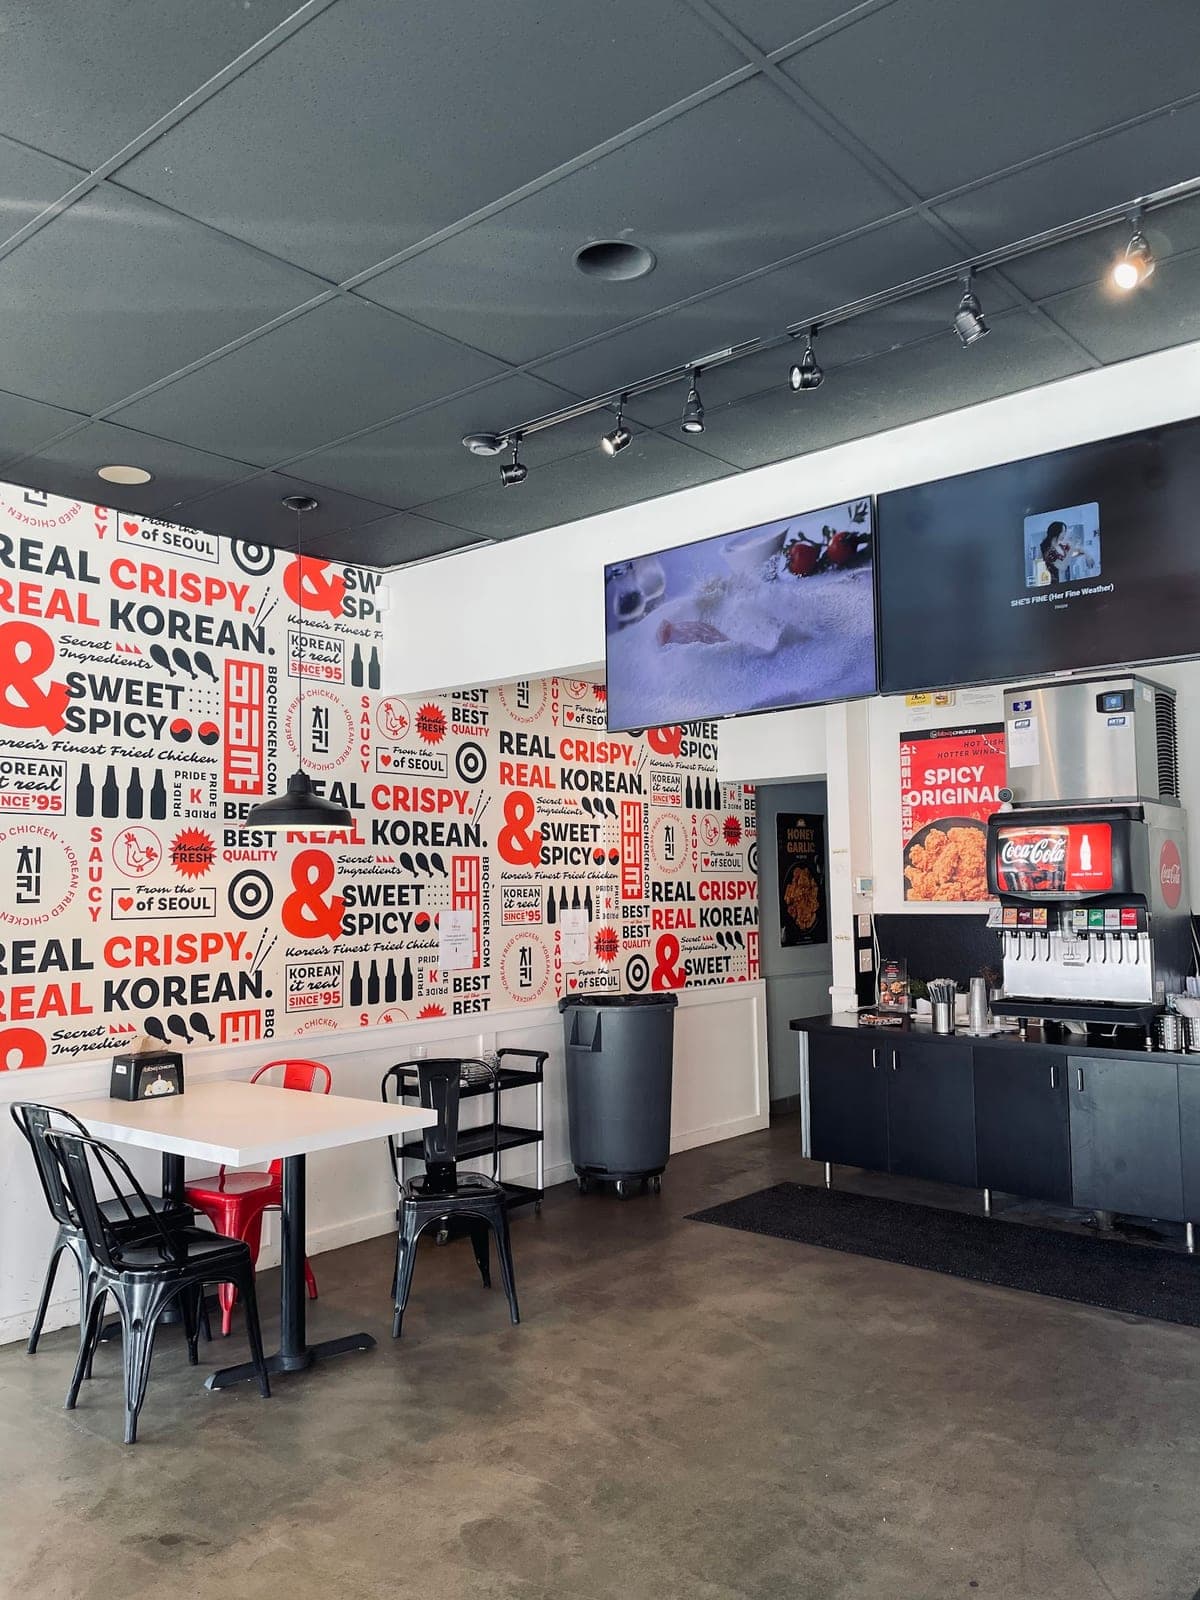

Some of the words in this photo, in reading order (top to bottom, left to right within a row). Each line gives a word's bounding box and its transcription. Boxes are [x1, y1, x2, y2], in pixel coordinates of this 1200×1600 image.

[162, 532, 215, 556] SEOUL
[109, 558, 256, 615] CRISPY.
[1065, 589, 1081, 600] Fine
[1081, 583, 1114, 595] Weather)
[110, 598, 276, 656] KOREAN.
[58, 634, 113, 651] Secret
[290, 634, 342, 654] KOREAN
[59, 647, 154, 670] Ingredients
[309, 650, 341, 664] real
[65, 671, 185, 710] SWEET
[64, 705, 169, 741] SPICY
[452, 707, 489, 726] BEST
[268, 666, 278, 796] BBQCHICKEN.COM
[360, 695, 370, 774] SAUCY
[451, 724, 490, 737] QUALITY
[51, 741, 106, 756] Finest
[110, 745, 155, 760] Fried
[158, 749, 218, 764] Chicken
[499, 730, 556, 760] REAL
[559, 738, 637, 767] CRISPY.
[937, 750, 970, 760] HOTTER
[174, 769, 207, 781] PRIDE
[407, 758, 445, 773] SEOUL
[499, 761, 556, 790] REAL
[560, 767, 648, 795] KOREAN.
[652, 774, 681, 785] KOREAN
[923, 765, 985, 786] SPICY
[189, 788, 203, 804] K
[371, 784, 474, 816] CRISPY.
[223, 830, 278, 848] BEST
[371, 818, 488, 848] KOREAN.
[497, 790, 544, 869] &
[540, 821, 601, 843] SWEET
[786, 828, 815, 841] HONEY
[223, 849, 278, 864] QUALITY
[540, 846, 593, 866] SPICY
[786, 841, 816, 854] GARLIC
[172, 852, 213, 864] FRESH
[337, 854, 375, 865] Secret
[88, 826, 104, 923] SAUCY
[337, 865, 403, 879] Ingredients
[281, 849, 346, 942] &
[342, 884, 425, 907] SWEET
[503, 888, 541, 898] KOREAN
[652, 881, 696, 903] REAL
[158, 896, 211, 911] SEOUL
[482, 856, 490, 968] BBQCHICKEN.COM
[622, 905, 651, 919] BEST
[341, 910, 414, 937] SPICY
[652, 908, 697, 931] REAL
[622, 924, 651, 939] BEST
[103, 931, 254, 969] CRISPY.
[285, 946, 331, 958] Korea's
[332, 942, 372, 955] Finest
[372, 940, 406, 951] Fried
[622, 939, 652, 950] QUALITY
[289, 965, 341, 980] KOREAN
[554, 929, 562, 998] SAUCY
[684, 955, 731, 977] SWEET
[308, 976, 340, 991] real
[452, 974, 491, 993] BEST
[589, 976, 618, 988] SEOUL
[0, 982, 94, 1023] EAL
[103, 969, 273, 1013] KOREAN.
[452, 997, 491, 1015] BEST
[51, 1024, 106, 1041] Secret
